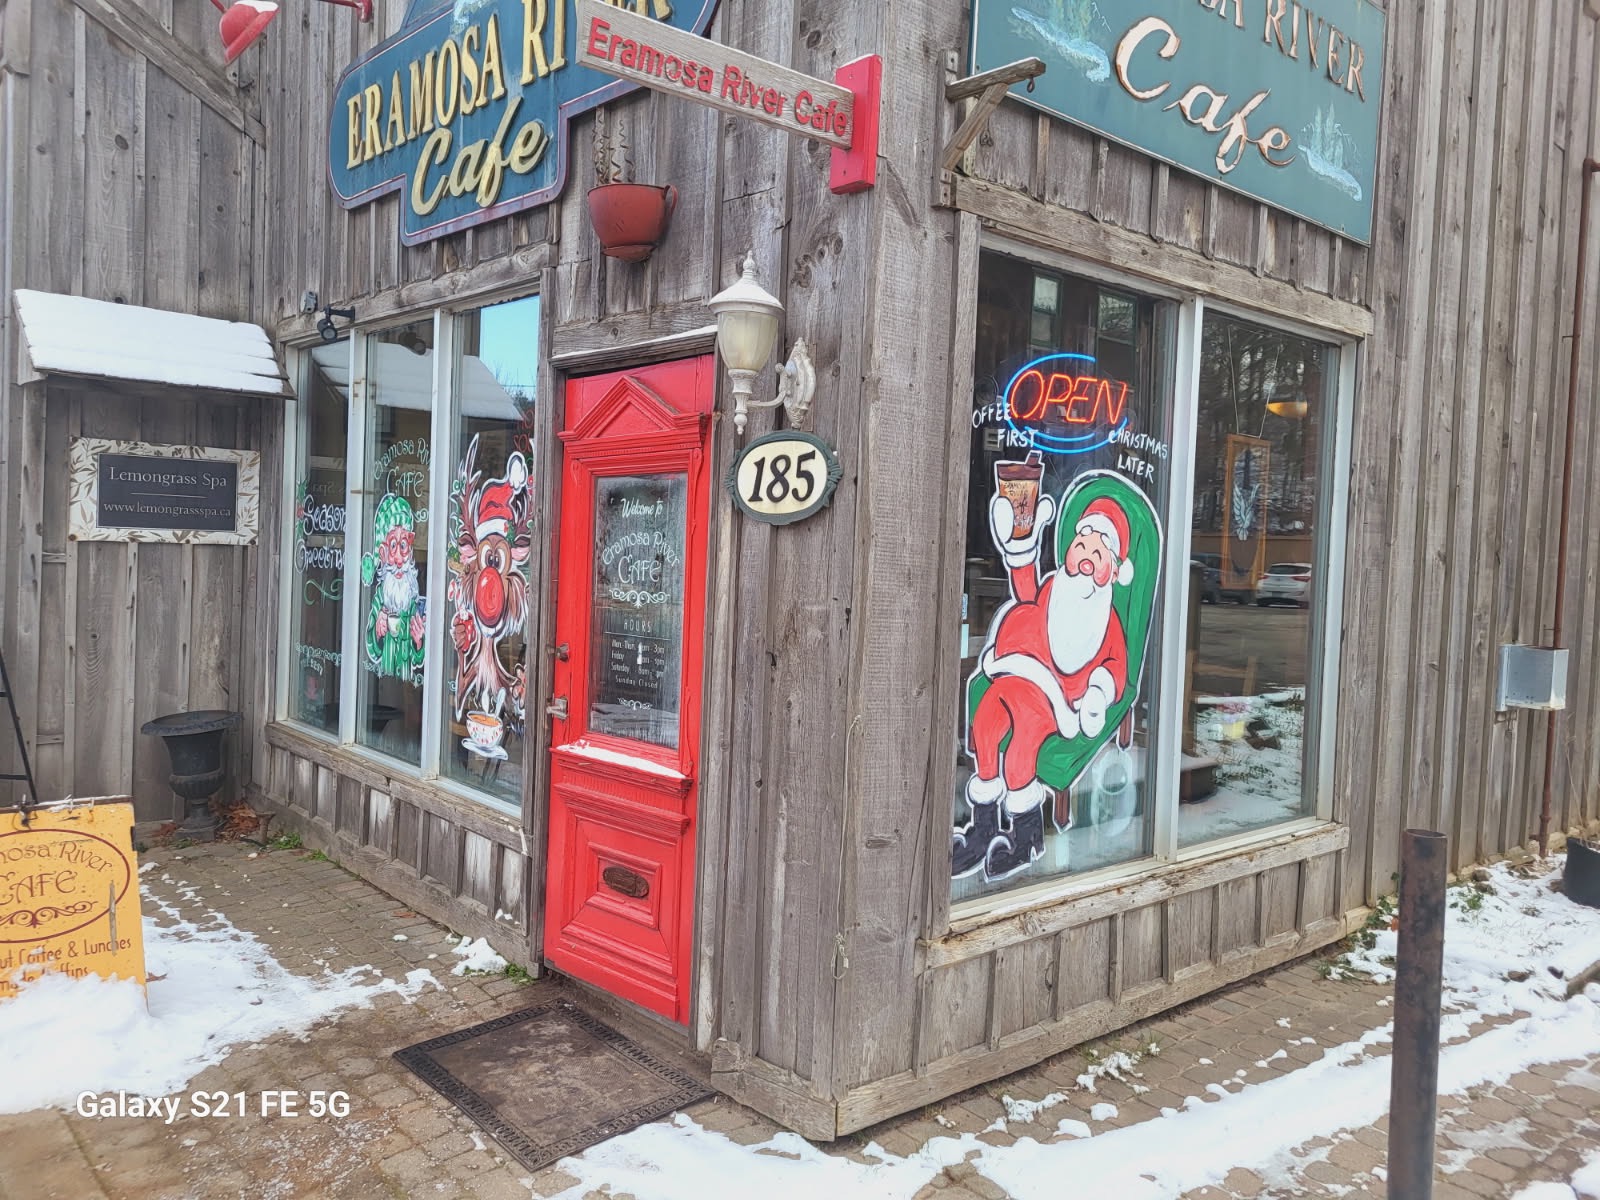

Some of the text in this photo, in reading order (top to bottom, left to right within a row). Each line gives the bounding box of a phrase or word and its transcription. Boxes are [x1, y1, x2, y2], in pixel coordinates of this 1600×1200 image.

[1263, 0, 1366, 103] RIVER
[346, 13, 507, 169] ERAMOSA
[587, 17, 714, 94] Eramosa
[720, 63, 788, 117] River
[794, 90, 848, 138] Cafe
[1116, 16, 1297, 174] Cafe
[411, 96, 550, 216] Cafe
[1010, 369, 1128, 425] OPEN
[973, 402, 1013, 428] OFFEE
[997, 428, 1040, 449] FIRST
[1108, 427, 1168, 460] CHRISTMAS
[108, 466, 228, 490] Lemongrass Spa
[747, 450, 816, 503] 185
[1117, 453, 1155, 484] LATER
[103, 500, 232, 518] www.lemongrassspa.ca
[621, 497, 655, 518] Welcome
[653, 531, 680, 567] River
[618, 554, 662, 584] CAFE
[623, 619, 652, 633] HOURS
[615, 674, 658, 689] Sunday Closed
[60, 840, 113, 873] River
[67, 940, 79, 958] &
